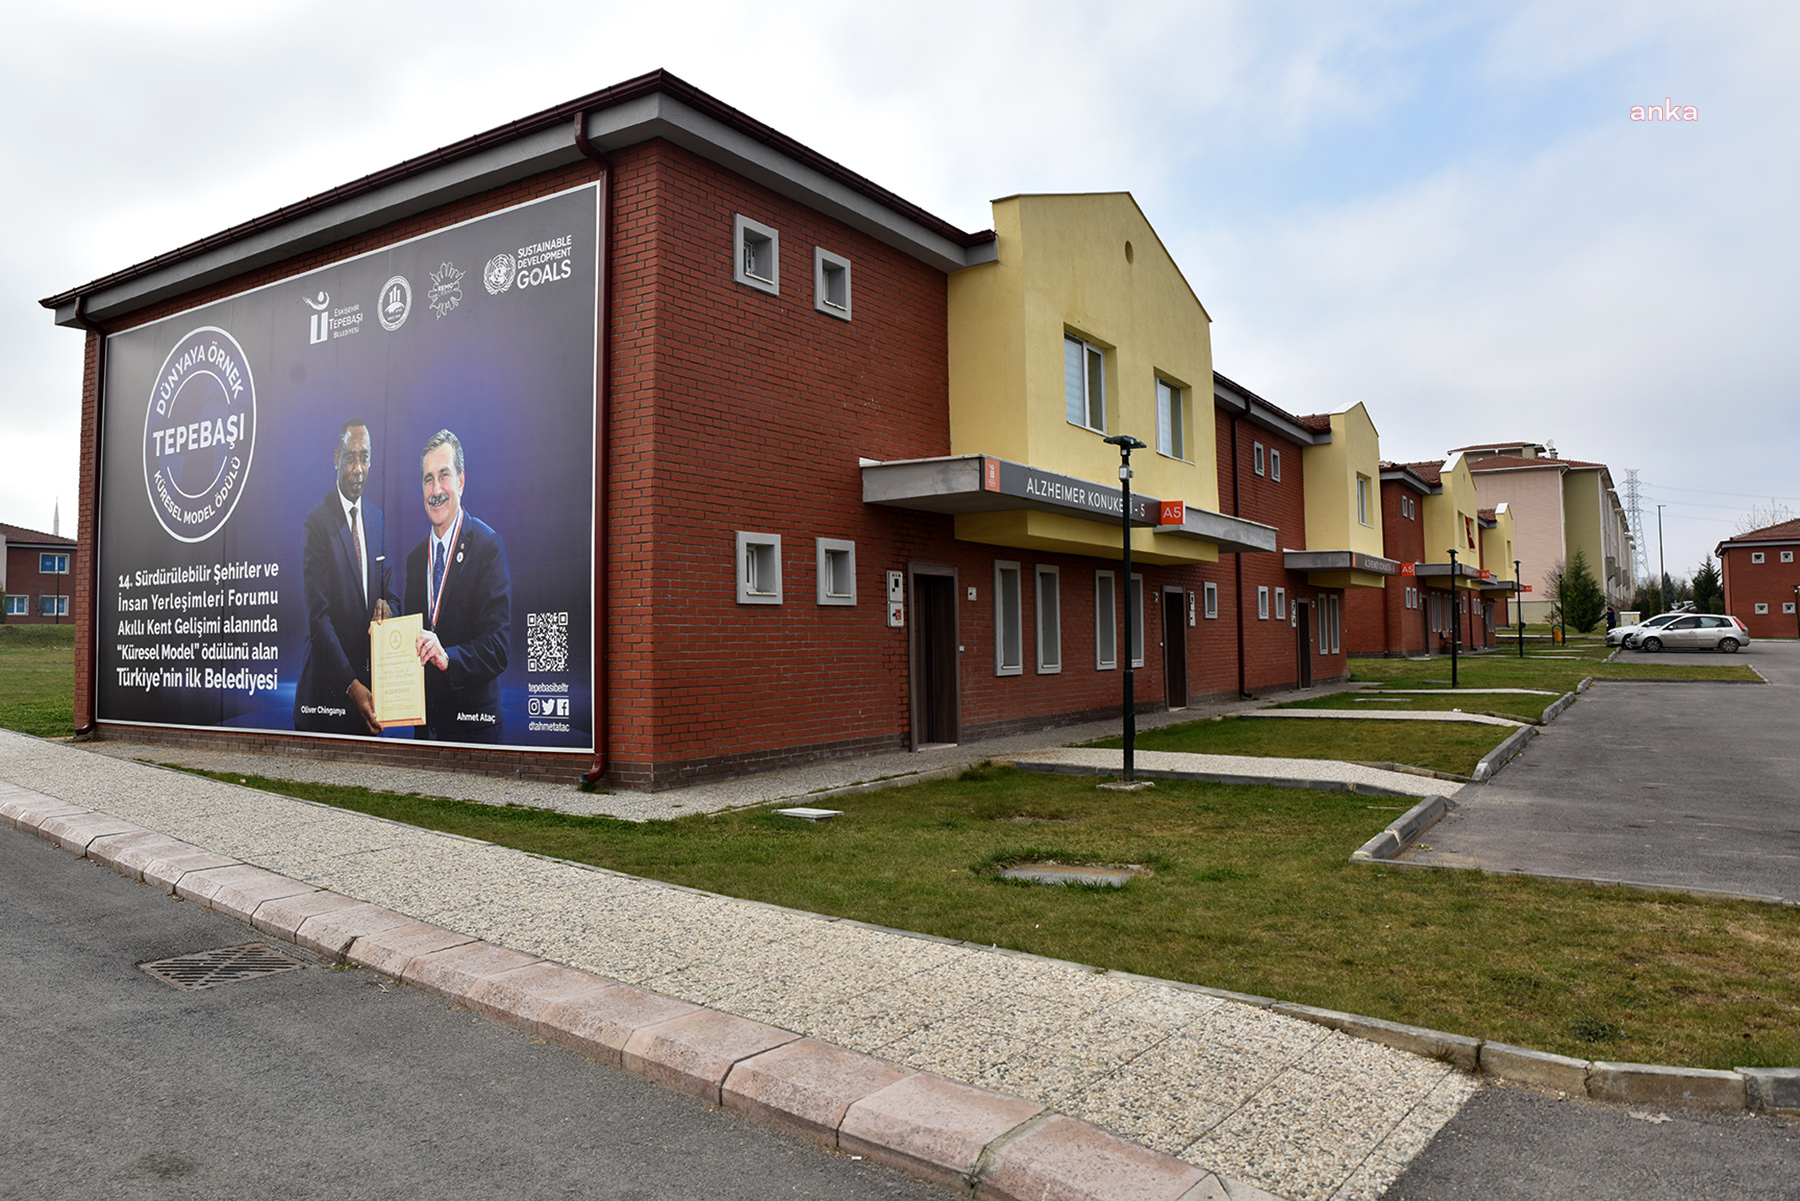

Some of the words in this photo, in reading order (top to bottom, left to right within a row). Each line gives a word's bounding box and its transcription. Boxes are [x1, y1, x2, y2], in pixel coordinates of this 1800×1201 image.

[518, 234, 572, 258] SUSTAINABLE
[518, 247, 572, 269] DEVELOPMENT
[517, 259, 571, 289] GOALS
[329, 312, 363, 330] TEPEBAŞI
[156, 344, 206, 416] DÜNYAYA
[207, 340, 244, 400] ÖRNEK
[152, 412, 245, 457] TEPEBAŞI
[154, 469, 182, 522] KÜRESEL
[183, 506, 216, 525] MODEL
[215, 455, 241, 508] ÖDÜLÜ
[1026, 477, 1086, 505] ALZHEIMER
[1088, 491, 1133, 515] KONUKEİ
[1162, 506, 1182, 519] A5
[118, 575, 133, 589] 14.
[135, 565, 212, 587] Sürdürülebilir
[213, 561, 262, 585] Şehirler
[264, 562, 279, 577] ve
[118, 592, 148, 612] İnsan
[151, 590, 224, 613] Yerleşimleri
[228, 589, 279, 607] Forumu
[117, 620, 145, 636] Akıllı
[147, 618, 172, 635] Kent
[174, 616, 221, 638] Gelişimi
[223, 614, 278, 634] alanında
[201, 643, 249, 660] ödülünü
[251, 642, 279, 660] alan
[185, 668, 202, 688] ilk
[204, 668, 278, 696] Belediyesi
[301, 705, 316, 714] Oliver
[456, 712, 479, 722] Ahmet
[480, 713, 496, 724] Ataç
